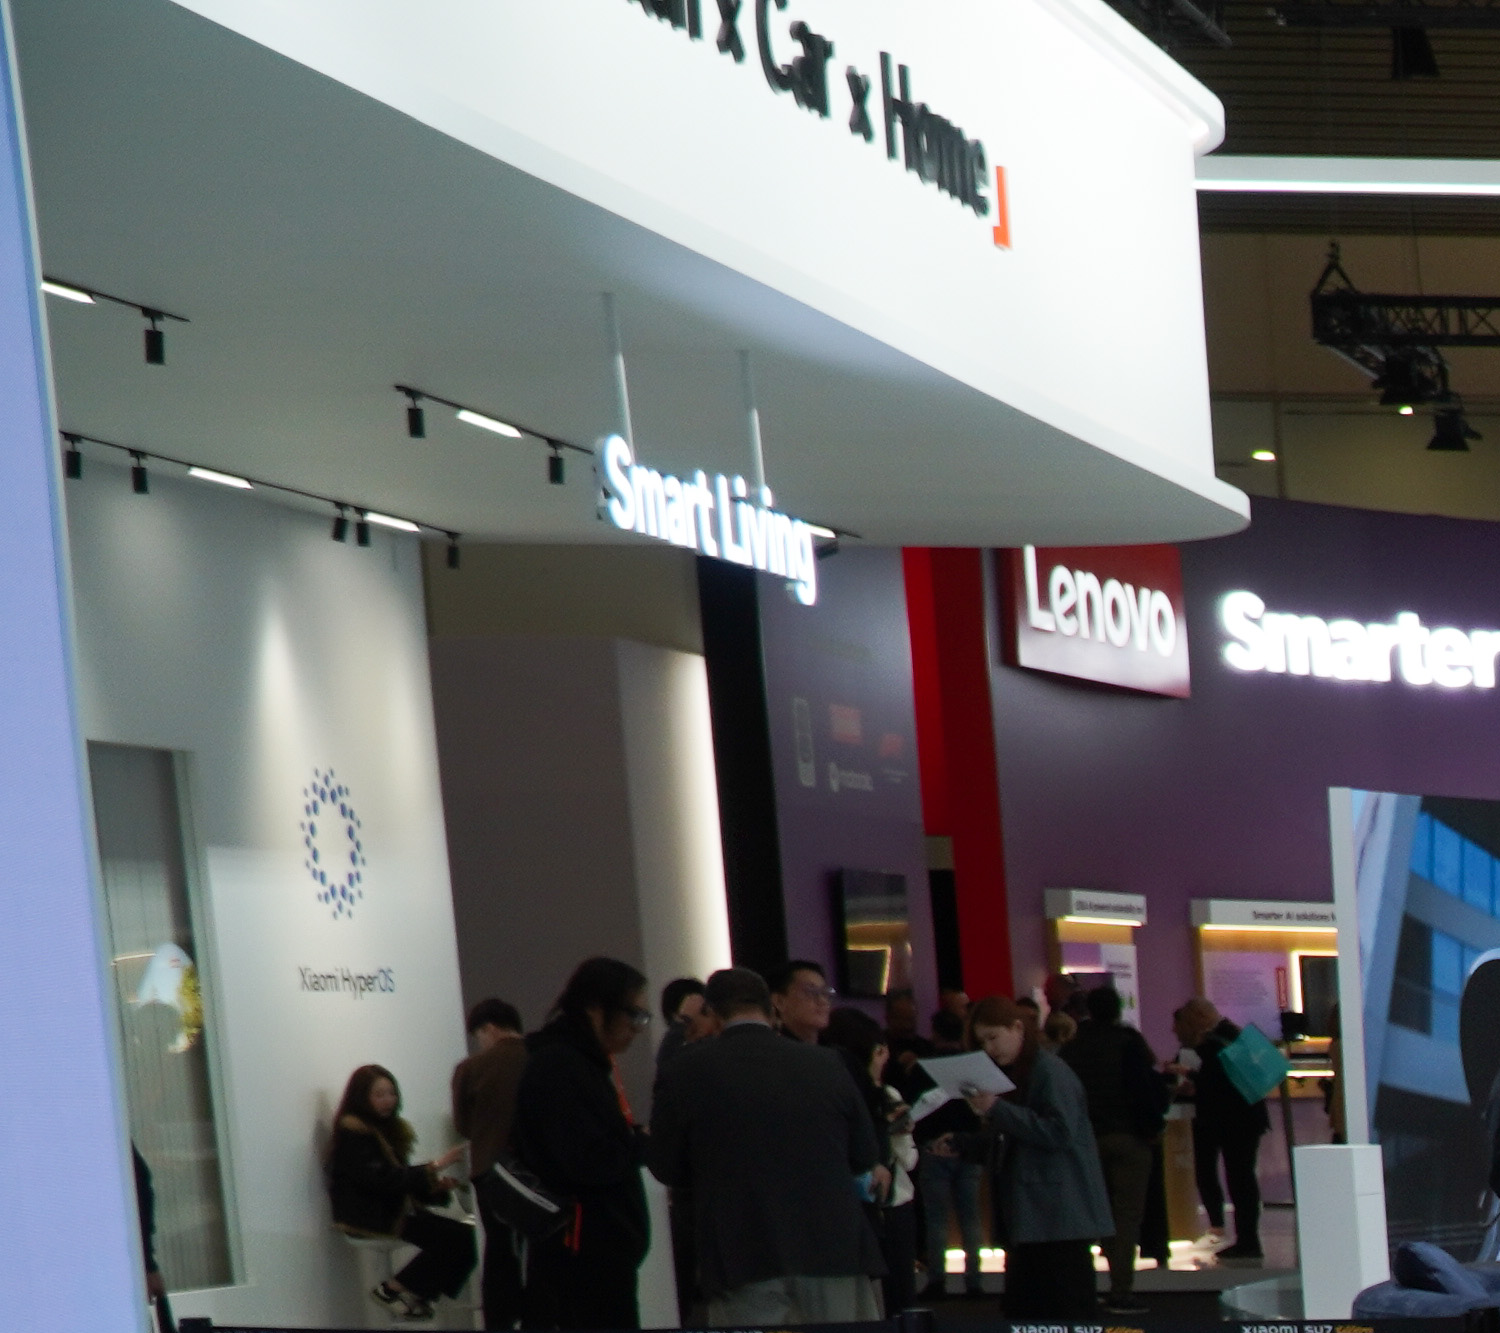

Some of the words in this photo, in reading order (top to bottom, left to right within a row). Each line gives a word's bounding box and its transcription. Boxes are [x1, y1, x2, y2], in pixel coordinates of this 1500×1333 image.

[880, 51, 990, 216] Home
[601, 434, 719, 558] Smart
[717, 474, 817, 606] Living
[1023, 544, 1176, 658] Lenovo
